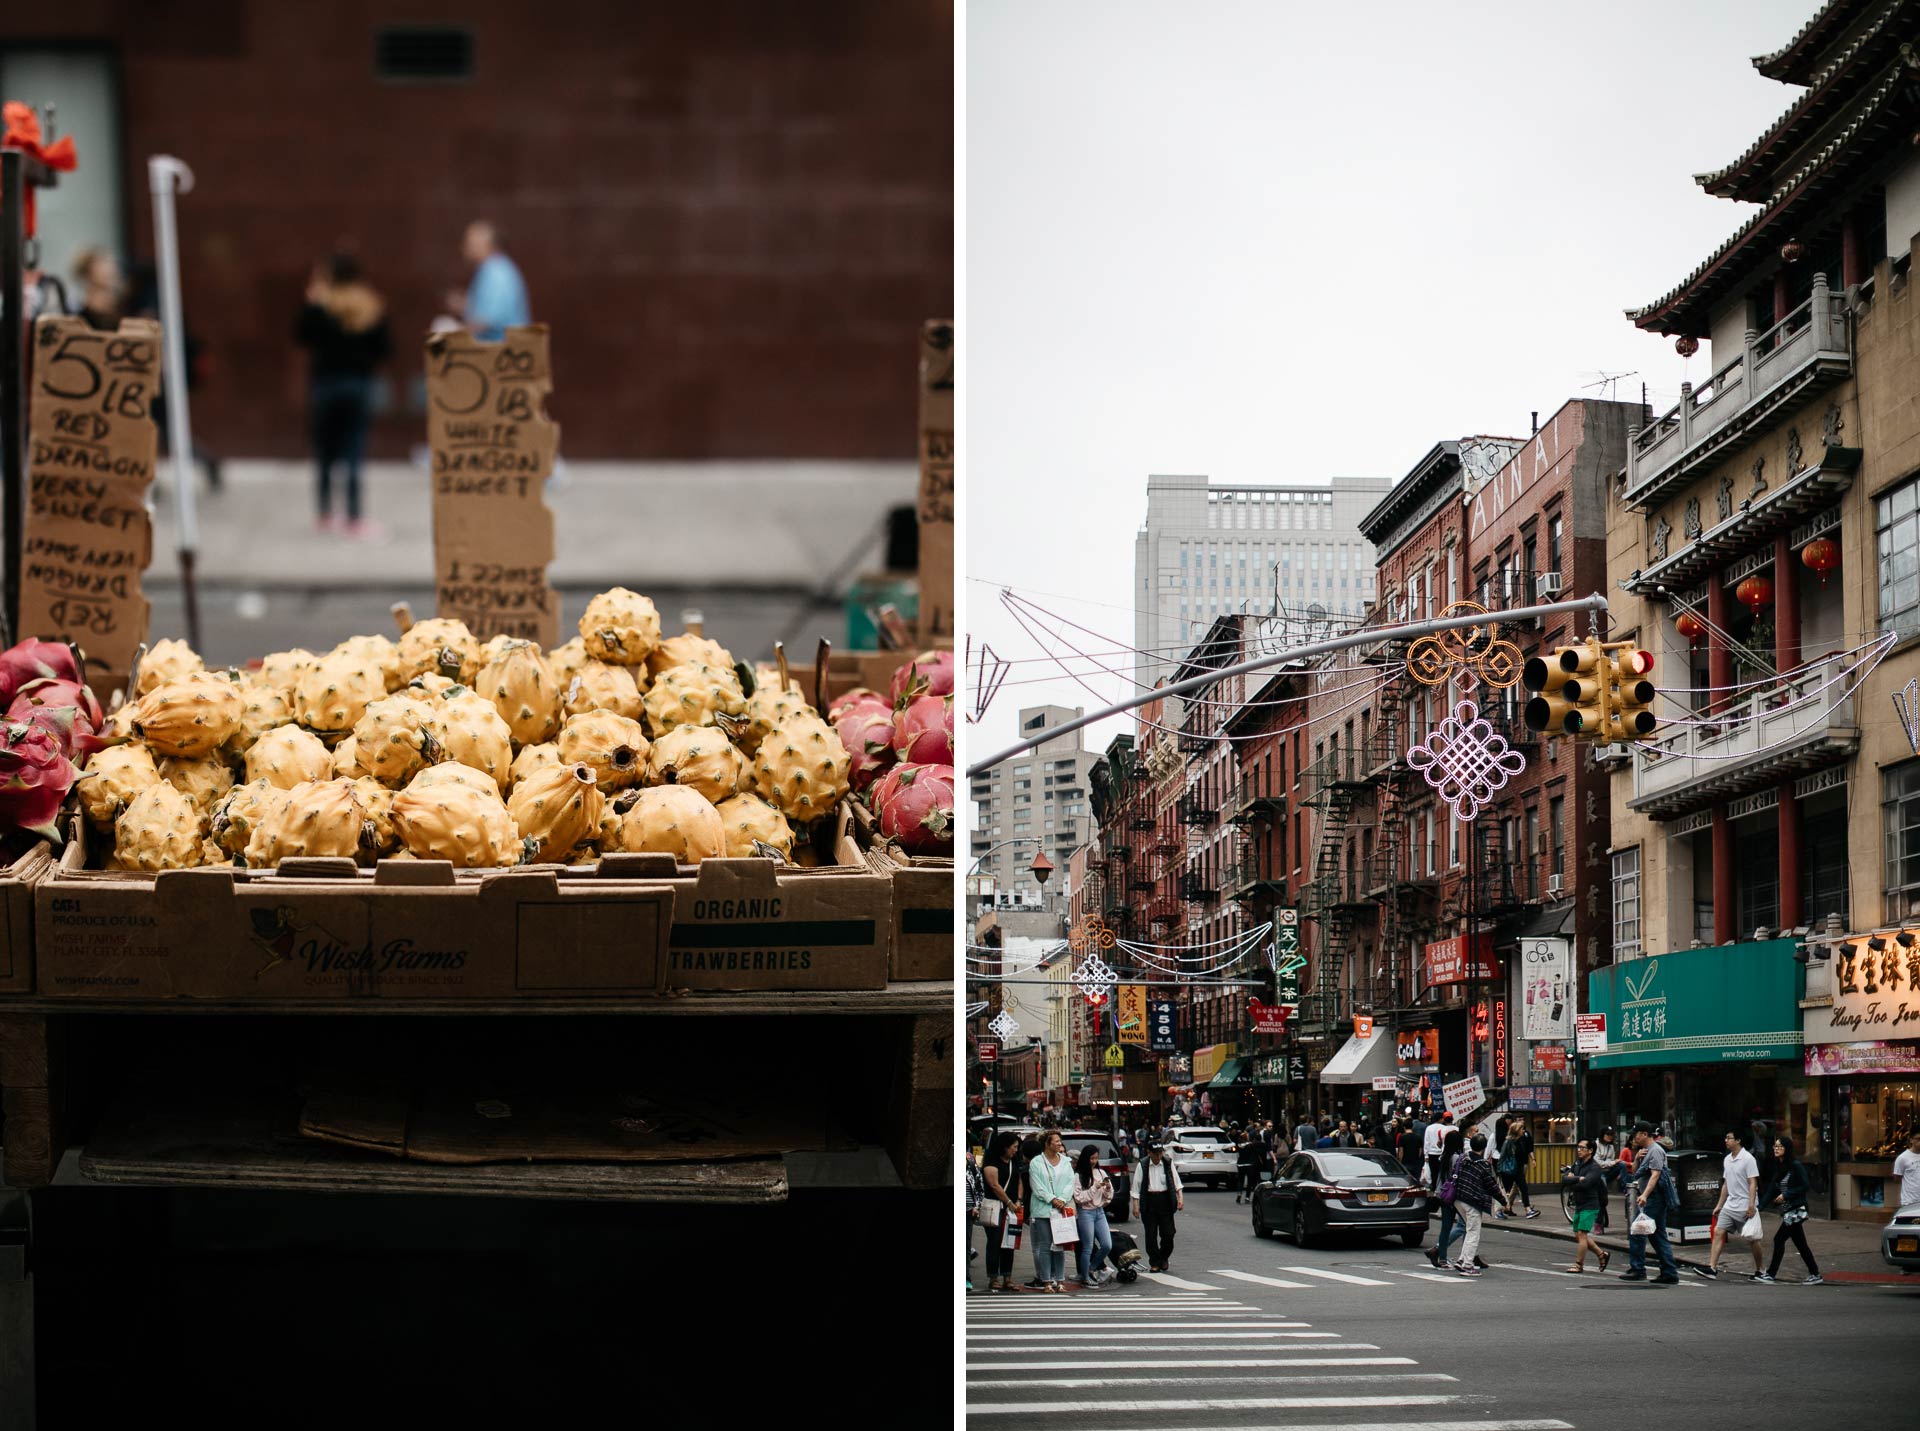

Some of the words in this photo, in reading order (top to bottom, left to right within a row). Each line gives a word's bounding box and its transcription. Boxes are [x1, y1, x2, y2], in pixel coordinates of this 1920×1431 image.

[51, 408, 110, 440] RED
[444, 421, 518, 447] WHITE
[33, 441, 148, 478] DRAGON
[434, 449, 540, 473] DRAGON
[32, 473, 106, 499] VERY
[1471, 416, 1559, 541] ANNA!
[28, 563, 128, 599] DRAGON
[49, 600, 118, 635] RED
[52, 915, 105, 926] PRODUCE
[110, 916, 126, 926] OF
[694, 898, 782, 919] ORGANIC
[53, 946, 89, 957] PLANT
[55, 934, 83, 944] WISH
[88, 934, 128, 944] FARMS
[300, 939, 377, 973] Wish
[378, 938, 472, 973] Farms
[1830, 1004, 1863, 1032] Hung
[1864, 1002, 1888, 1025] Too
[1121, 1031, 1145, 1041] WONG
[1496, 1001, 1505, 1078] READINGS
[1398, 1043, 1414, 1060] CoCo
[1443, 1078, 1477, 1094] PERFUME
[1451, 1095, 1478, 1109] WATCH
[1458, 1105, 1475, 1115] BELT
